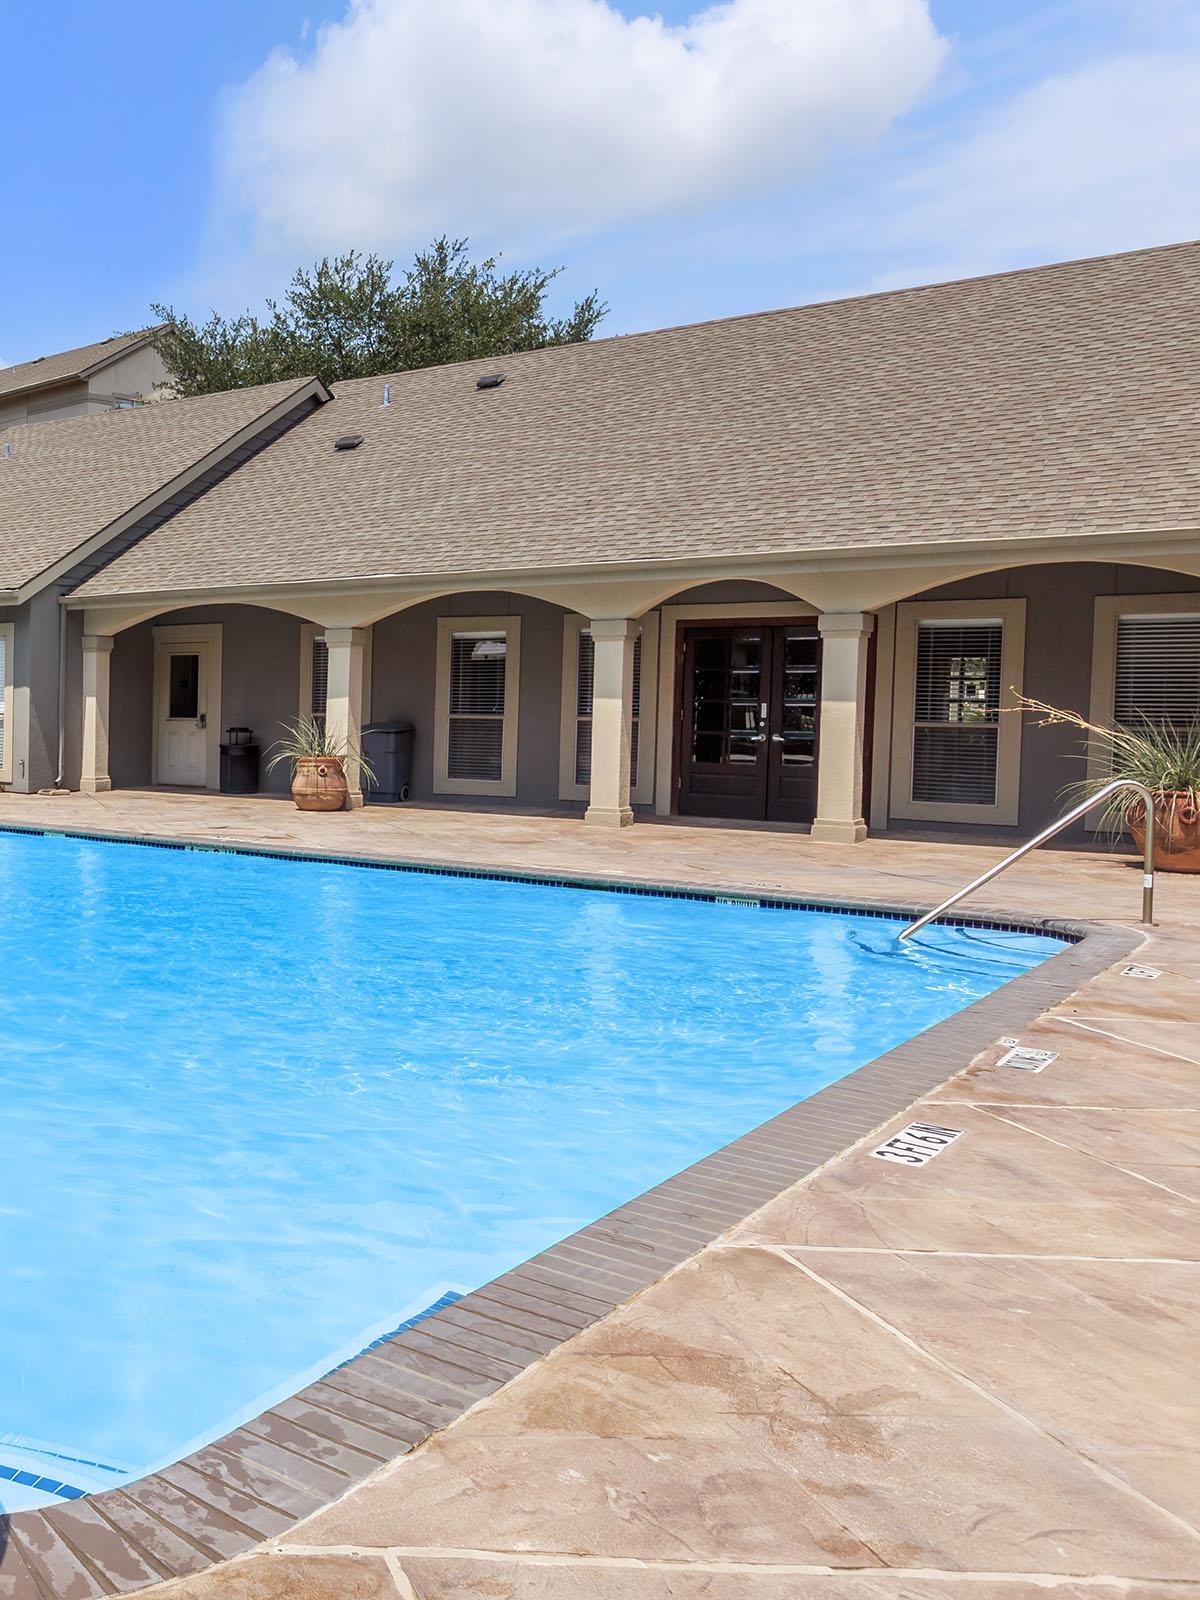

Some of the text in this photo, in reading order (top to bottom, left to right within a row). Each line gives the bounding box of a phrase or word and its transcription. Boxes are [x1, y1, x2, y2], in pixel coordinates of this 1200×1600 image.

[875, 1121, 962, 1163] 3 FT 6 IN
